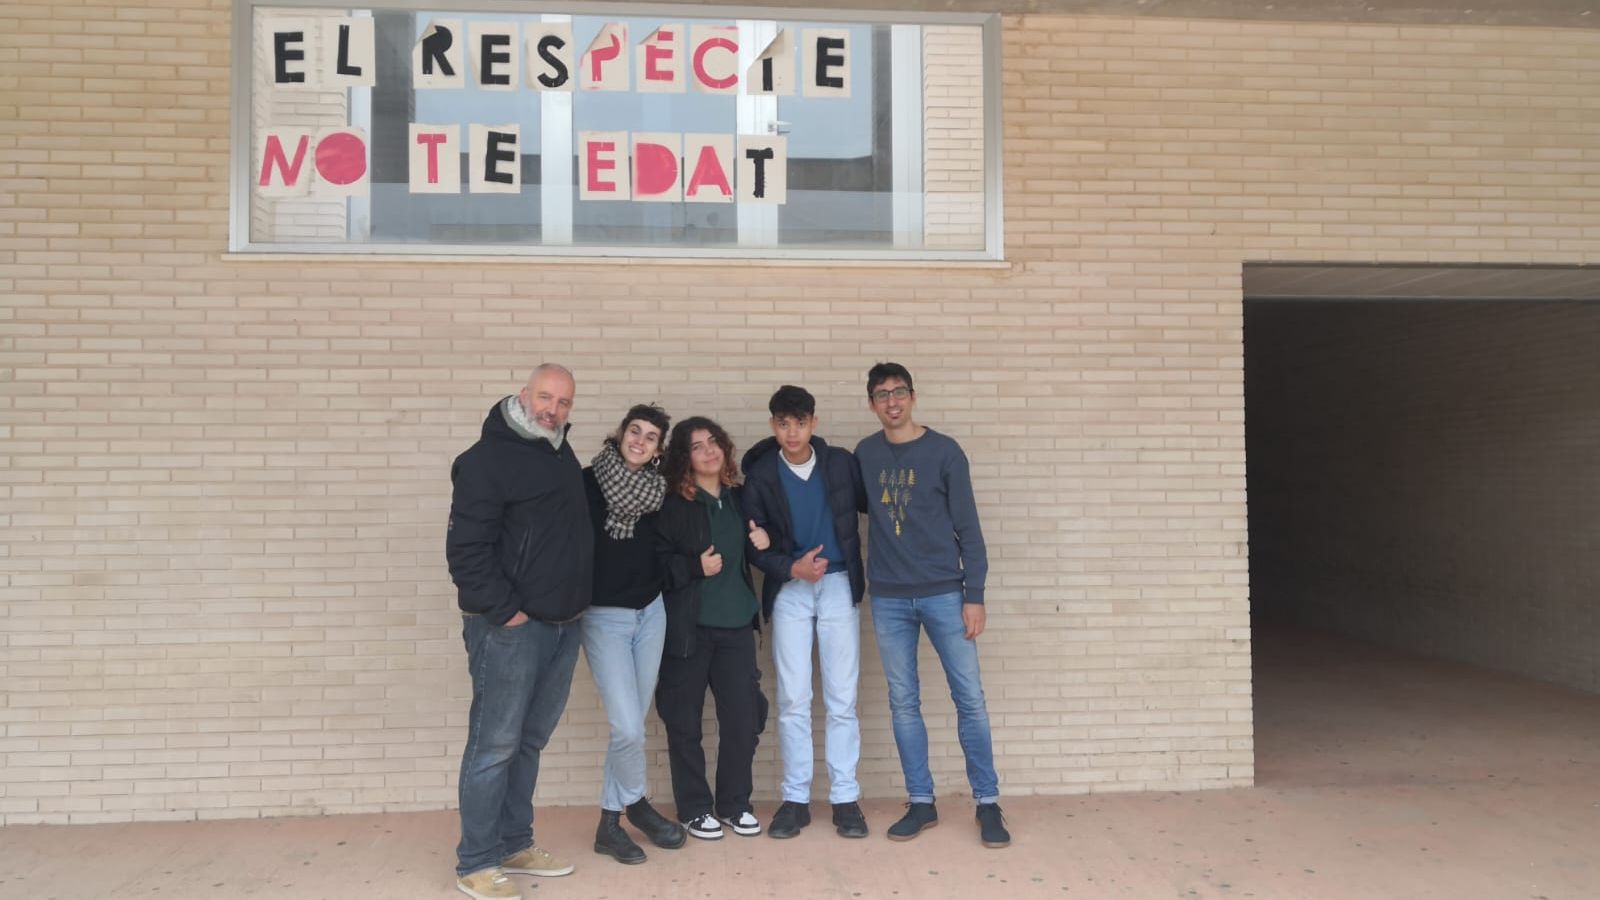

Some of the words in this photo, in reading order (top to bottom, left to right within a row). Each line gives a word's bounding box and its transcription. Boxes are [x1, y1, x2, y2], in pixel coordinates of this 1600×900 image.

[273, 24, 362, 84] EL
[258, 131, 367, 187] NO
[416, 130, 517, 185] TE
[586, 140, 774, 199] EDAT
